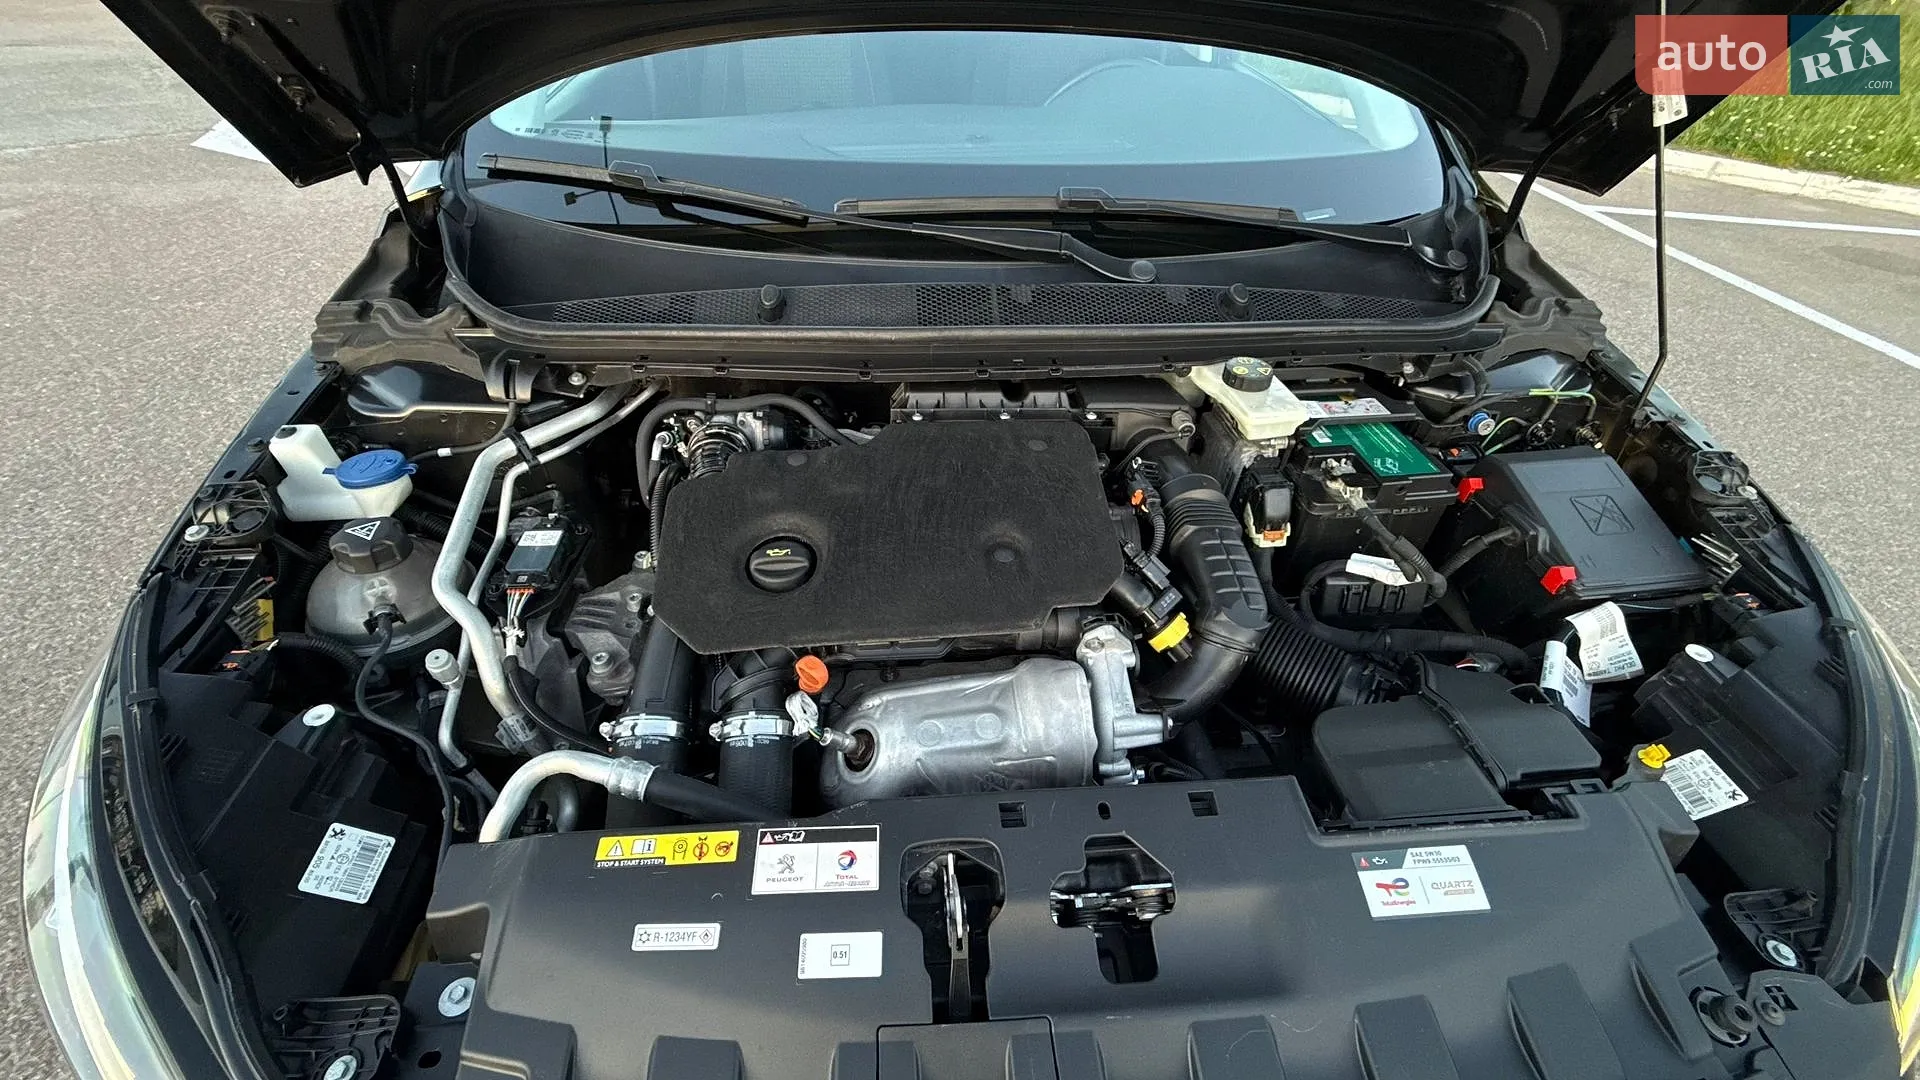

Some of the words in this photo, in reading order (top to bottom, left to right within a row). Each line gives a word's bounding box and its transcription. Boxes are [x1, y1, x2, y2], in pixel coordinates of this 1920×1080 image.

[596, 860, 614, 868] STOP
[620, 859, 640, 867] START
[640, 858, 664, 866] SYSTEM
[1431, 880, 1474, 890] QUARTZ
[653, 931, 698, 942] R-1234YF
[832, 950, 848, 960] 0.51
